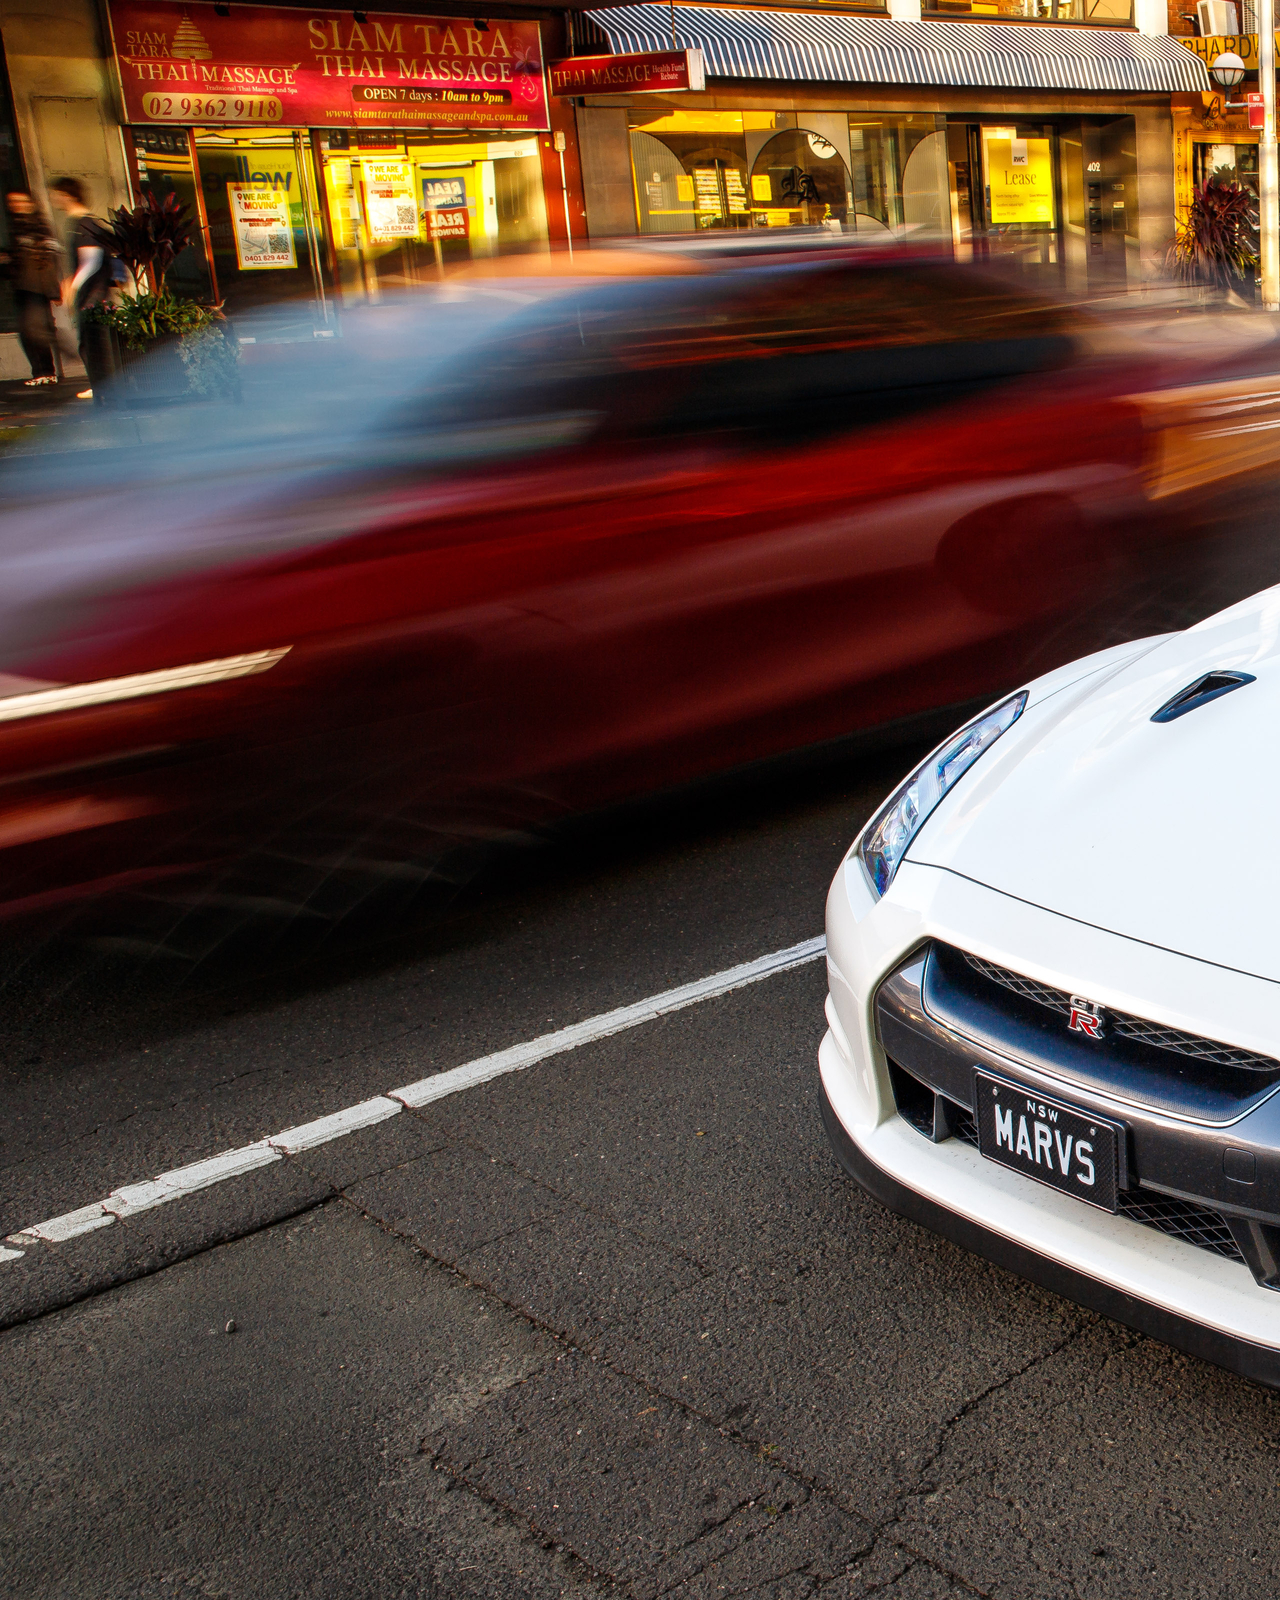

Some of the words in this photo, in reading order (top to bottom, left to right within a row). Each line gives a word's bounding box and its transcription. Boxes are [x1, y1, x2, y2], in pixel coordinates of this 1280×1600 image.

[127, 31, 167, 45] SIAM
[307, 19, 407, 53] SIAM
[414, 25, 513, 59] TARA
[127, 44, 172, 58] TARA
[132, 63, 188, 81] THAI
[200, 66, 296, 85] MASSAGE
[315, 54, 386, 78] THAI
[397, 58, 513, 82] MASSAGE
[554, 70, 586, 87] THAI
[592, 65, 651, 85] MASSAGE
[652, 64, 670, 73] Health
[672, 63, 685, 72] Fund
[660, 72, 679, 80] Rebate
[252, 86, 275, 94] Massage
[363, 88, 397, 100] OPEN
[400, 89, 407, 100] 7
[409, 89, 432, 103] days
[441, 90, 468, 102] 10am
[471, 92, 480, 102] to
[483, 92, 504, 105] 9pm
[150, 98, 173, 116] 02
[180, 98, 227, 117] 9362
[234, 99, 277, 118] 9118
[326, 108, 529, 123] www.siamtarathaimassageandspa.com.au
[374, 165, 386, 173] WE
[386, 165, 399, 173] ARE
[1087, 162, 1101, 172] 402
[375, 174, 406, 182] MOVING
[1005, 170, 1037, 186] Lease
[244, 202, 278, 210] MOVING
[1070, 995, 1106, 1015] GT
[1068, 1007, 1106, 1040] R
[1026, 1100, 1059, 1123] NSW
[994, 1103, 1096, 1186] MARVS
